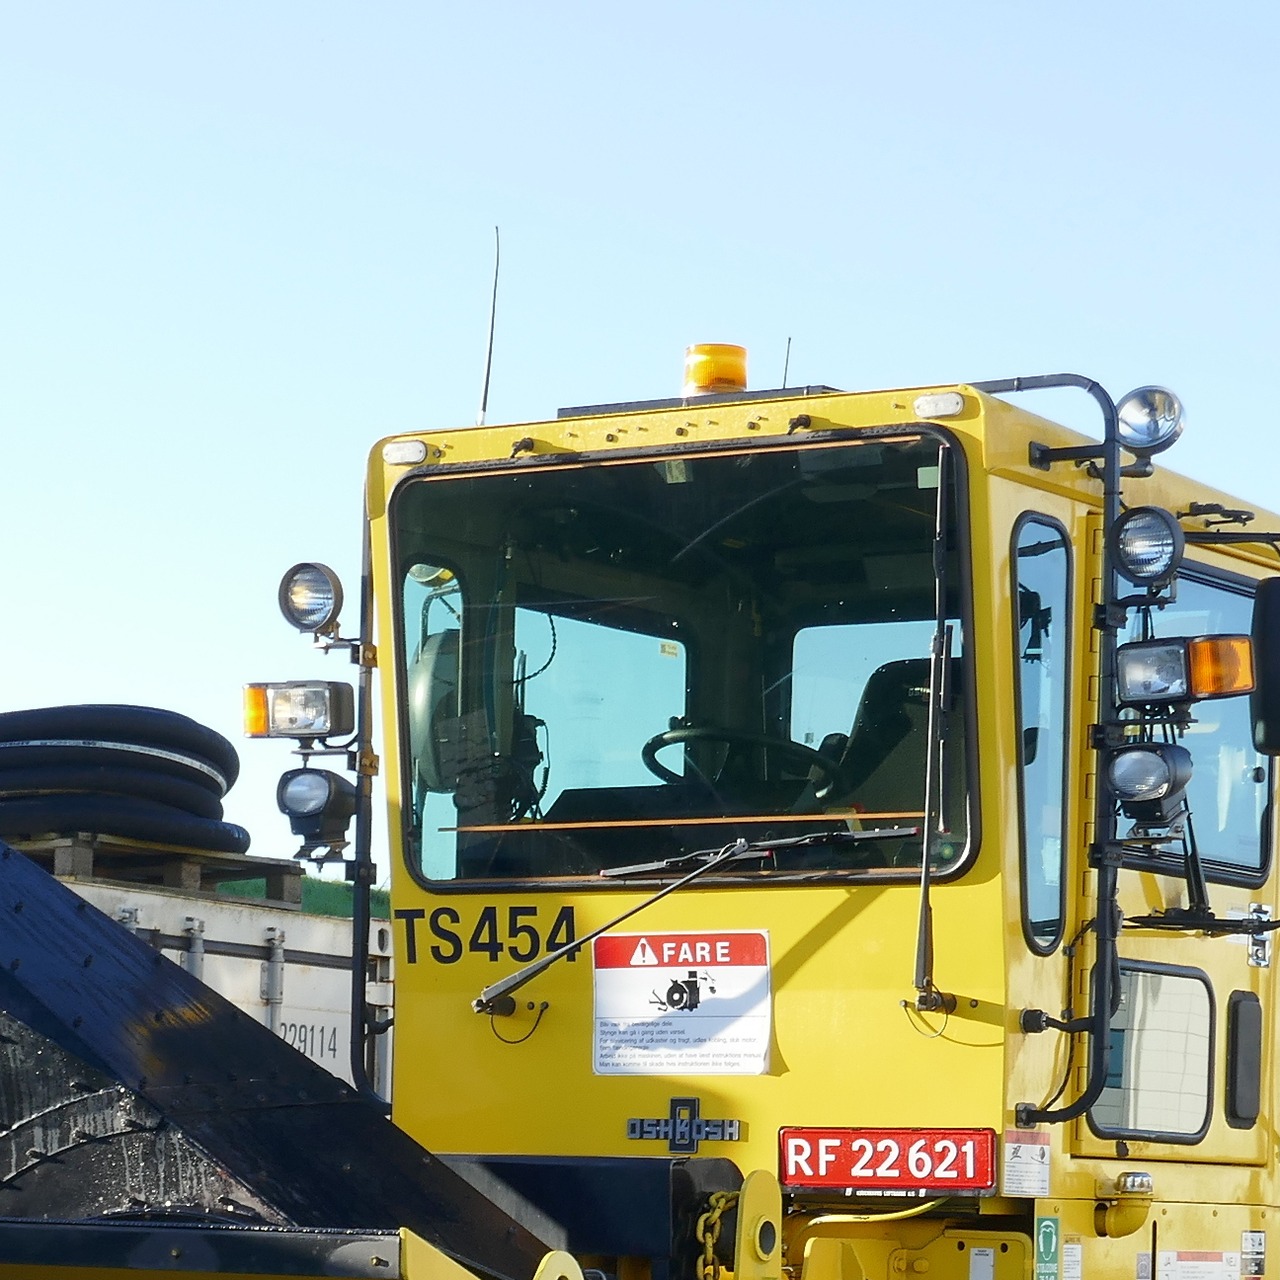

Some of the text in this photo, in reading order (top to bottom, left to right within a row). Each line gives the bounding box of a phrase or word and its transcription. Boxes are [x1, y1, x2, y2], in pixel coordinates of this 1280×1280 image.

[394, 906, 581, 964] TS454
[662, 941, 731, 963] FARE
[627, 1107, 740, 1144] OSHKOSH
[787, 1138, 841, 1176] RF
[851, 1138, 900, 1177] 22
[908, 1139, 975, 1179] 621
